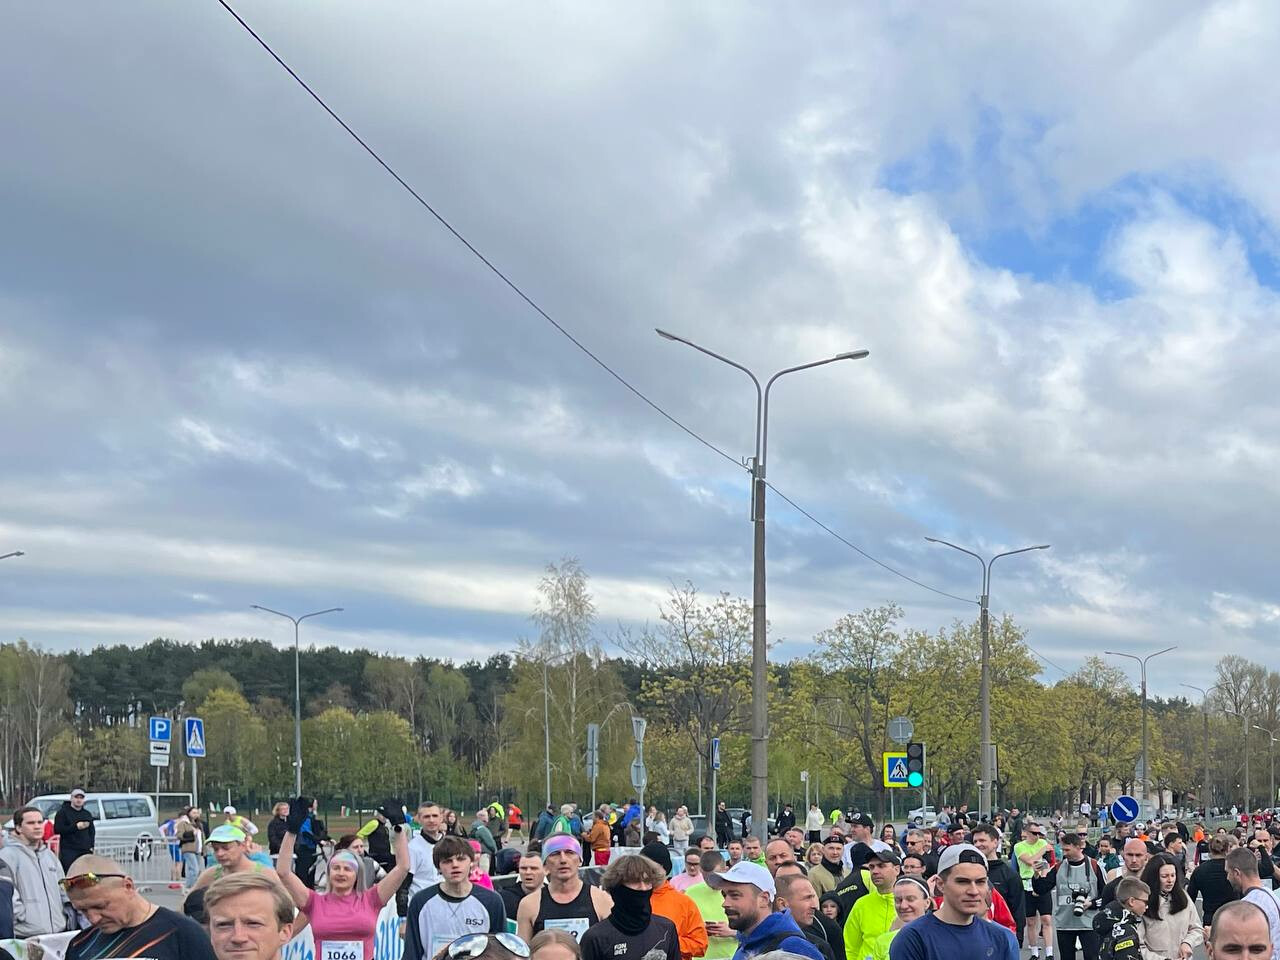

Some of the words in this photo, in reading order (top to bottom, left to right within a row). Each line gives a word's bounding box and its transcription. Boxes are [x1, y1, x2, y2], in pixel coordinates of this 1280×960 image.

[155, 720, 167, 738] P
[465, 918, 484, 926] BSJ
[327, 951, 356, 960] 1066
